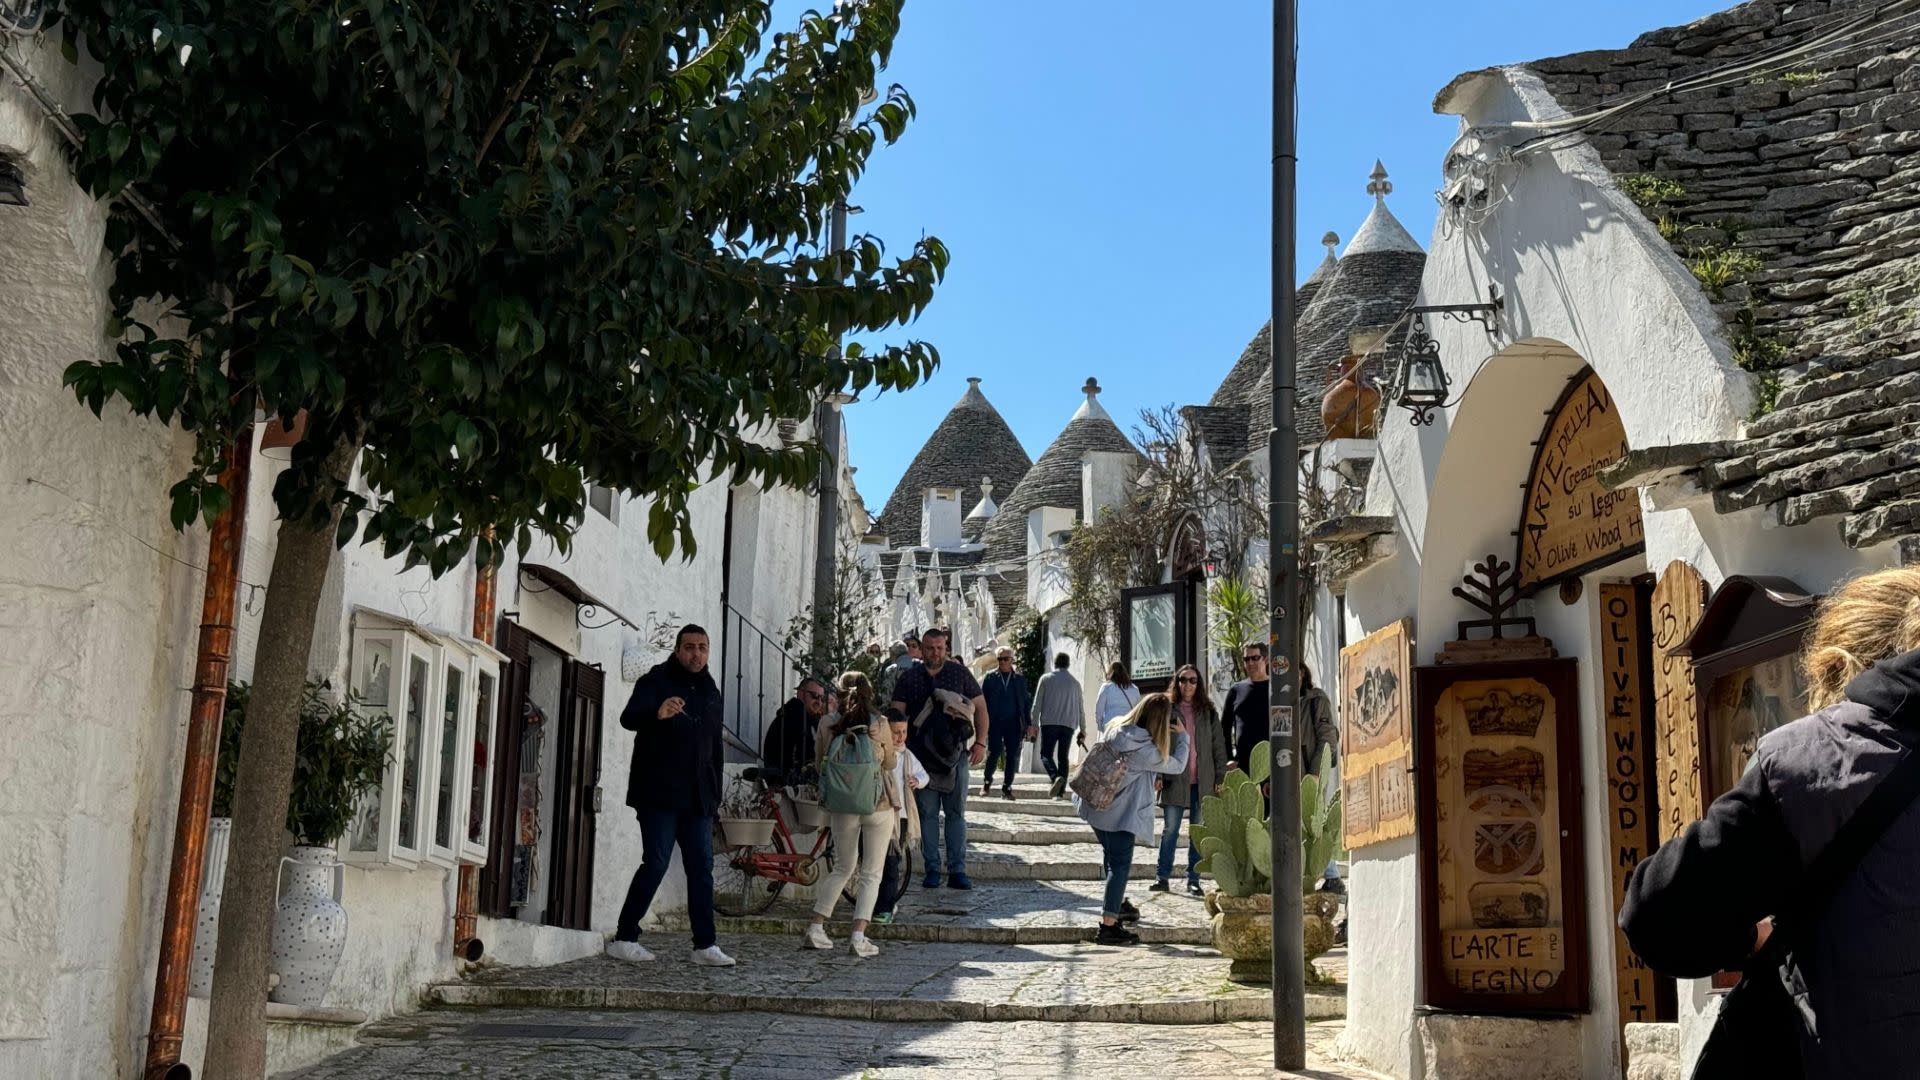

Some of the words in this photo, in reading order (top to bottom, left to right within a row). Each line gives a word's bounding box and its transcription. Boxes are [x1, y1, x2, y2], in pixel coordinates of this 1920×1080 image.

[1590, 487, 1627, 518] Legno
[1546, 541, 1578, 568] Olive
[1585, 520, 1622, 552] Wood
[1628, 513, 1643, 537] H
[1608, 597, 1631, 717] OLIVE
[1656, 602, 1683, 840] Botteg
[1614, 732, 1638, 829] WOOD
[1451, 933, 1533, 960] L'ARTE
[1549, 933, 1558, 960] DEL
[1455, 966, 1554, 992] LEGNO
[1629, 978, 1647, 1021] IT
